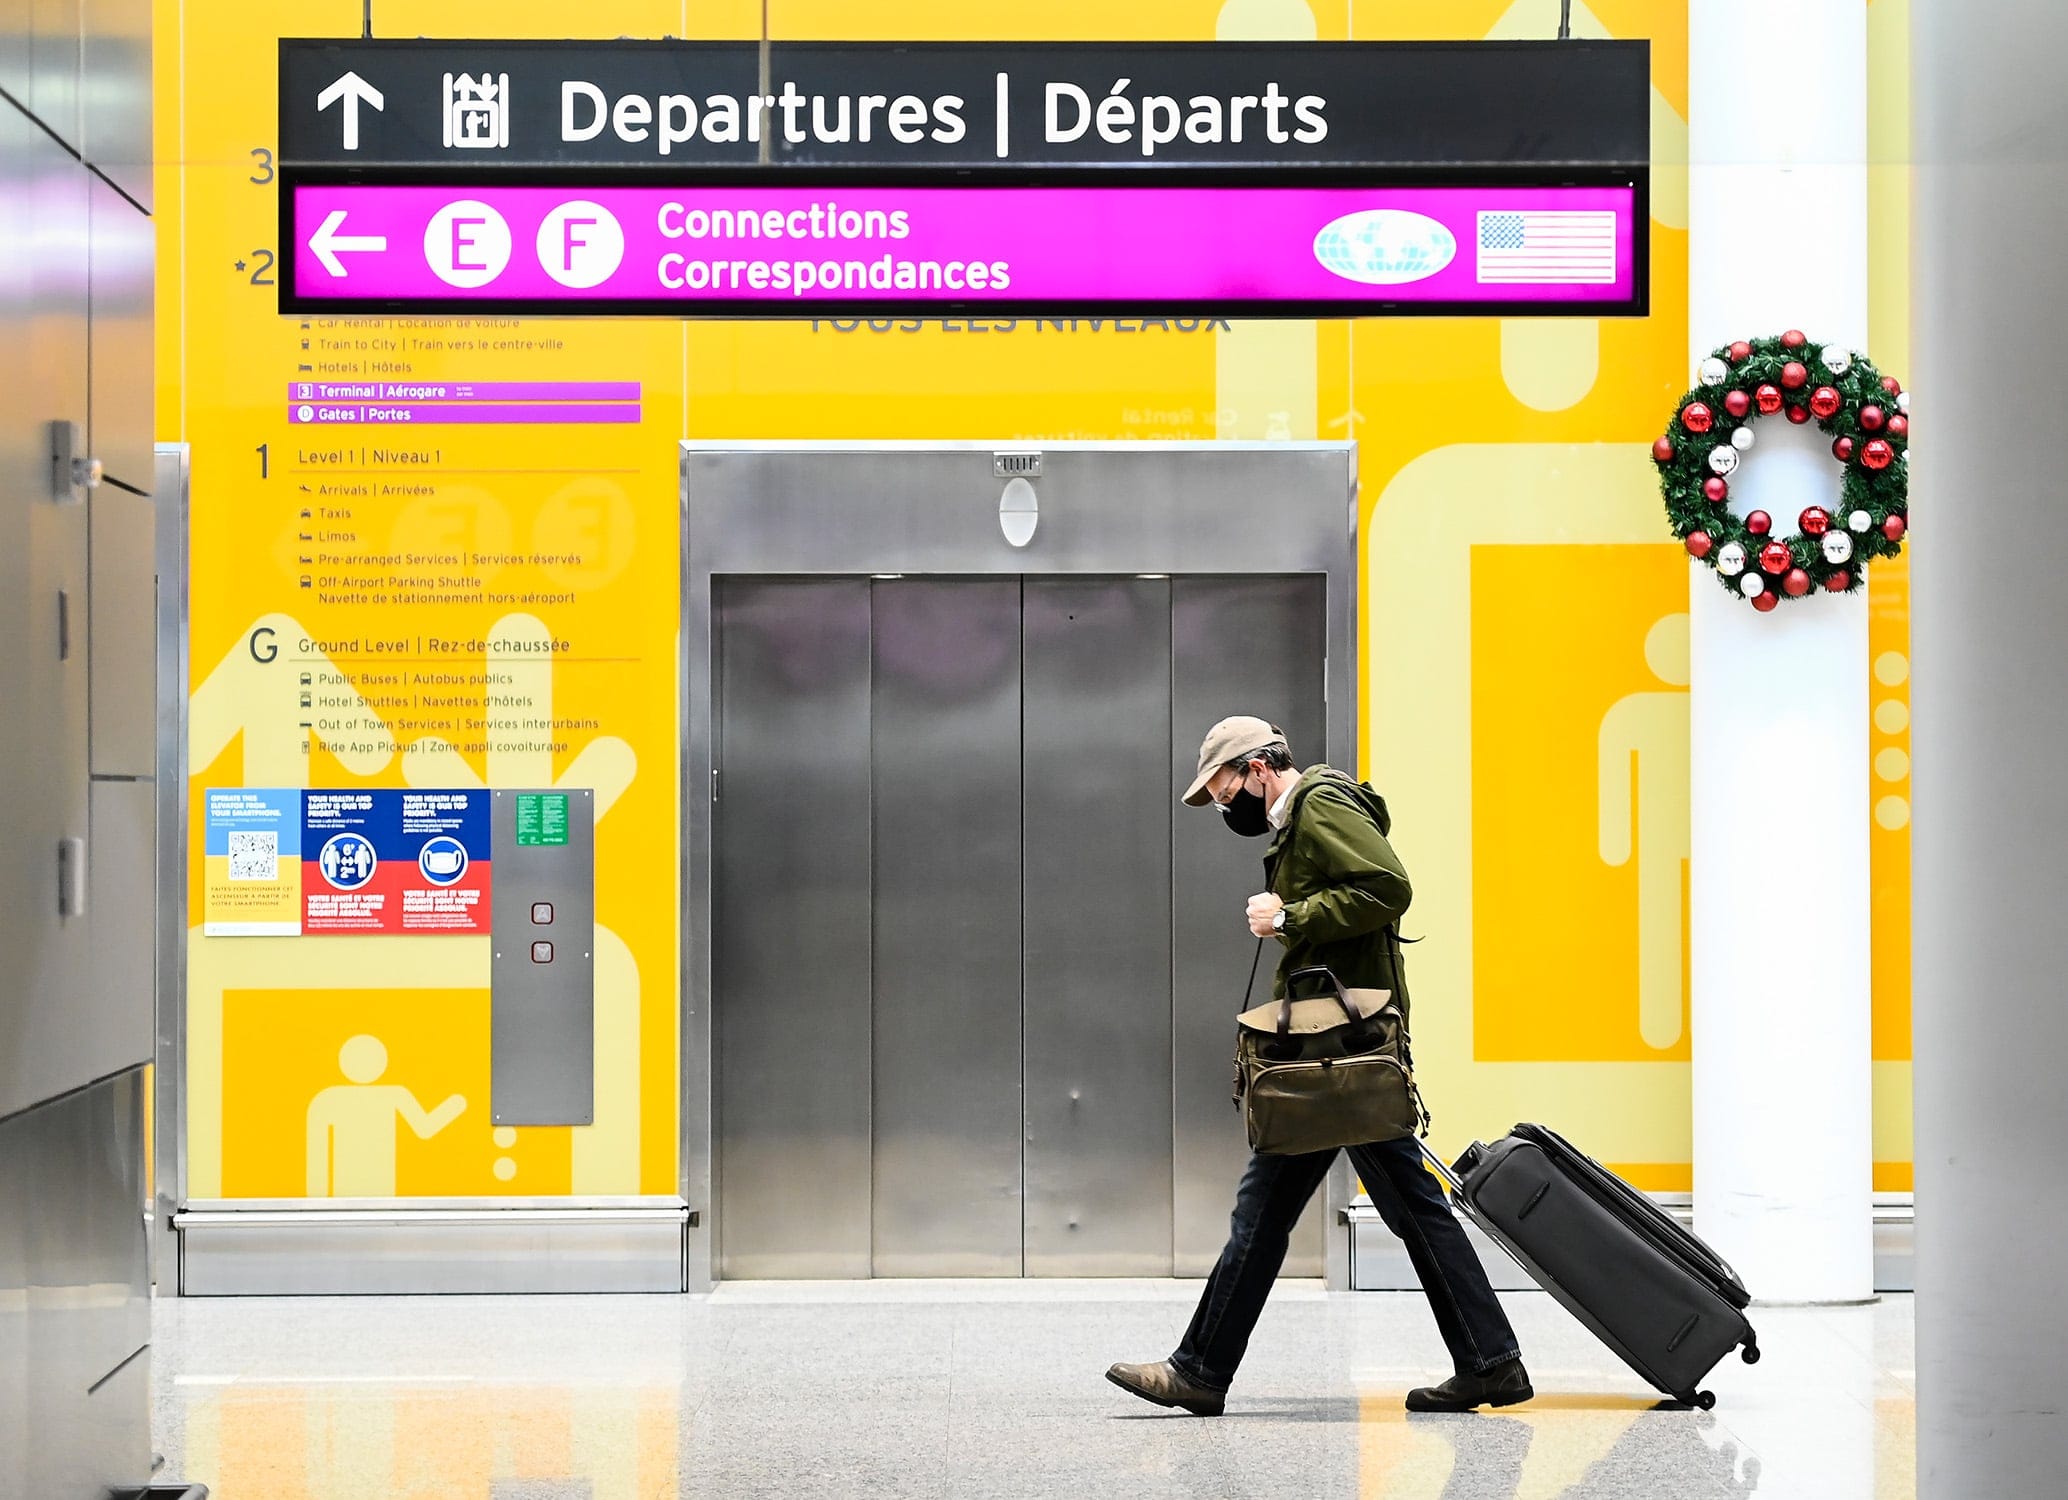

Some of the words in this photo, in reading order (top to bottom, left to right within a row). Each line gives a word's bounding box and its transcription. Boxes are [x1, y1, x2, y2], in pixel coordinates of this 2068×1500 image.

[560, 80, 967, 156] Departures
[1044, 77, 1329, 156] Départs
[249, 147, 275, 186] 3
[657, 202, 911, 240] Connections
[451, 217, 487, 272] E
[562, 217, 598, 272] F
[249, 248, 275, 286] 2
[657, 253, 1011, 297] Correspondances
[319, 338, 351, 351] Train
[355, 339, 368, 351] to
[371, 338, 397, 352] City
[412, 338, 444, 351] Train
[447, 340, 474, 351] vers
[478, 339, 489, 350] le
[492, 338, 564, 351] centre-ville
[318, 361, 359, 373] Hotels
[371, 361, 412, 374] Hôtels
[318, 384, 376, 398] Terminal
[386, 383, 447, 400] Aérogare
[318, 406, 356, 420] Gates
[368, 406, 412, 420] Portes
[255, 442, 268, 481] 1
[298, 448, 343, 465] Level
[349, 449, 354, 464] 1
[372, 448, 430, 465] Niveau
[435, 449, 440, 464] 1
[318, 483, 368, 497] Arrivals
[381, 484, 435, 497] Arrivées
[319, 507, 352, 519] Taxis
[318, 530, 356, 543] Limos
[318, 553, 402, 568] Pre-arranged
[405, 553, 459, 566] Services
[471, 553, 524, 566] Services
[528, 552, 581, 566] réservés
[318, 576, 385, 590] Off-Airport
[388, 576, 435, 590] Parking
[438, 576, 482, 588] Shuttle
[318, 592, 368, 605] Navette
[372, 592, 388, 605] de
[391, 592, 484, 606] stationnement
[487, 591, 576, 606] hors-aéroport
[249, 626, 279, 665] G
[298, 638, 359, 654] Ground
[365, 638, 409, 654] Level
[428, 636, 570, 654] Rez-de-chaussée
[318, 672, 357, 686] Public
[361, 673, 399, 686] Buses
[412, 673, 466, 685] Autobus
[469, 672, 513, 687] publics
[318, 695, 353, 708] Hotel
[356, 695, 409, 709] Shuttles
[422, 695, 479, 708] Navettes
[482, 695, 533, 708] d'hôtels
[318, 718, 341, 731] Out
[345, 718, 358, 730] of
[362, 718, 394, 730] Town
[397, 718, 452, 731] Services
[465, 718, 519, 730] Services
[522, 718, 599, 730] interurbains
[318, 741, 346, 753] Ride
[349, 741, 374, 755] App
[377, 740, 418, 755] Pickup
[429, 741, 460, 753] Zone
[463, 741, 493, 755] appli
[496, 740, 569, 755] covoiturage
